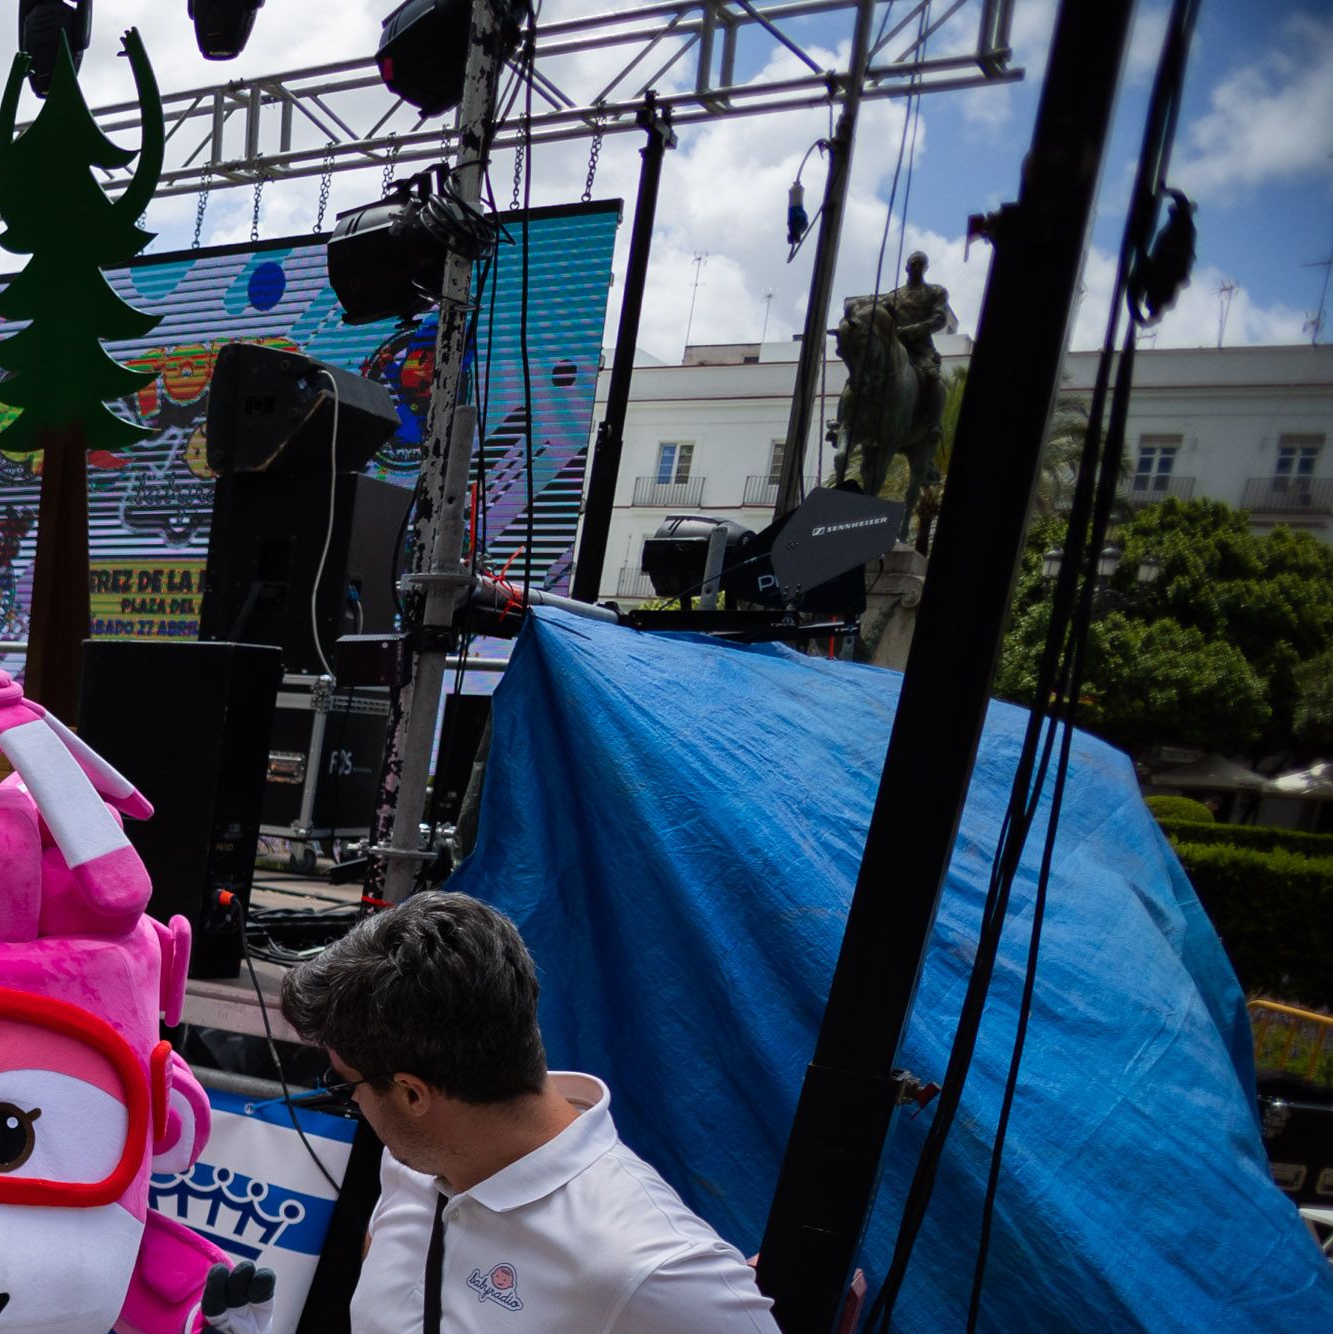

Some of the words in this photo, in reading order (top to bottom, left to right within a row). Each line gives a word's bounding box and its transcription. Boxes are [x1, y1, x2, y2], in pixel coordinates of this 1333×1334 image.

[826, 516, 888, 533] SENNHEISER
[90, 569, 132, 593] EREZ
[137, 569, 163, 593] DE
[168, 569, 192, 592] LA
[120, 598, 166, 614] PLAZA
[137, 620, 154, 635] 27
[469, 1272, 521, 1308] babyradio
